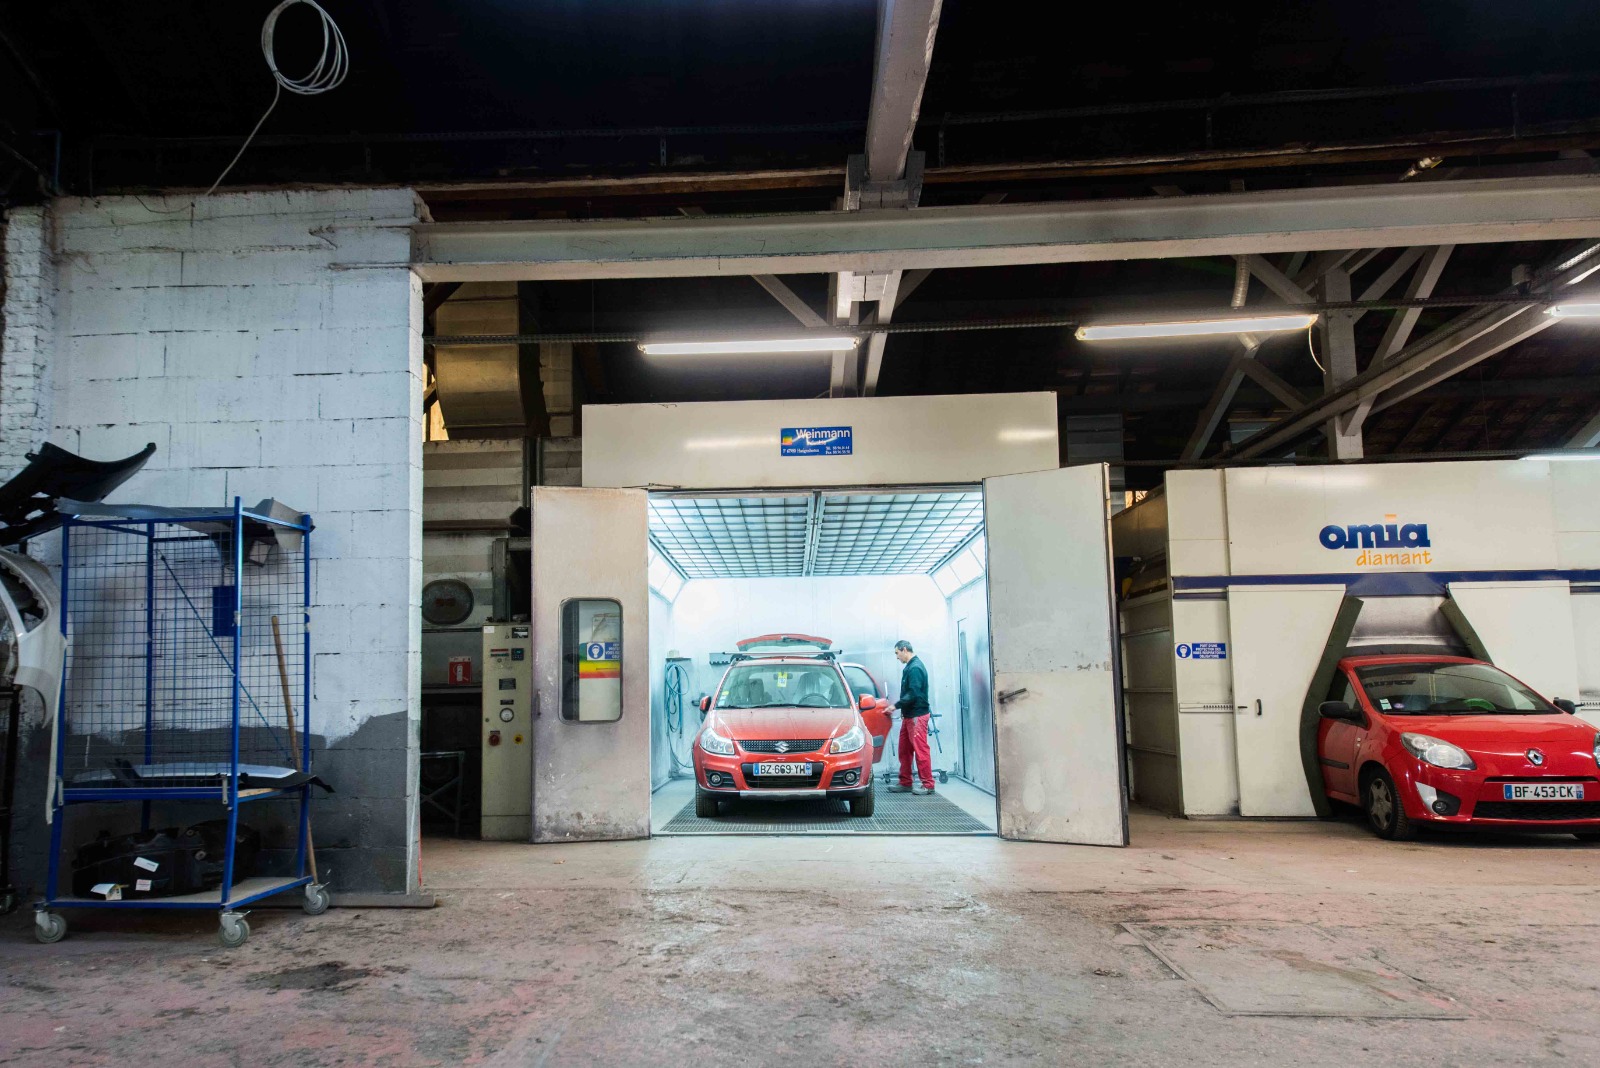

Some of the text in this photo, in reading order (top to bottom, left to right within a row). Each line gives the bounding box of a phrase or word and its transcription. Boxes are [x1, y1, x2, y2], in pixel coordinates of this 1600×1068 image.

[795, 428, 851, 439] Weinmann
[1318, 513, 1431, 550] omia
[1356, 549, 1433, 567] diamant
[1514, 786, 1574, 798] BF-453-CK
